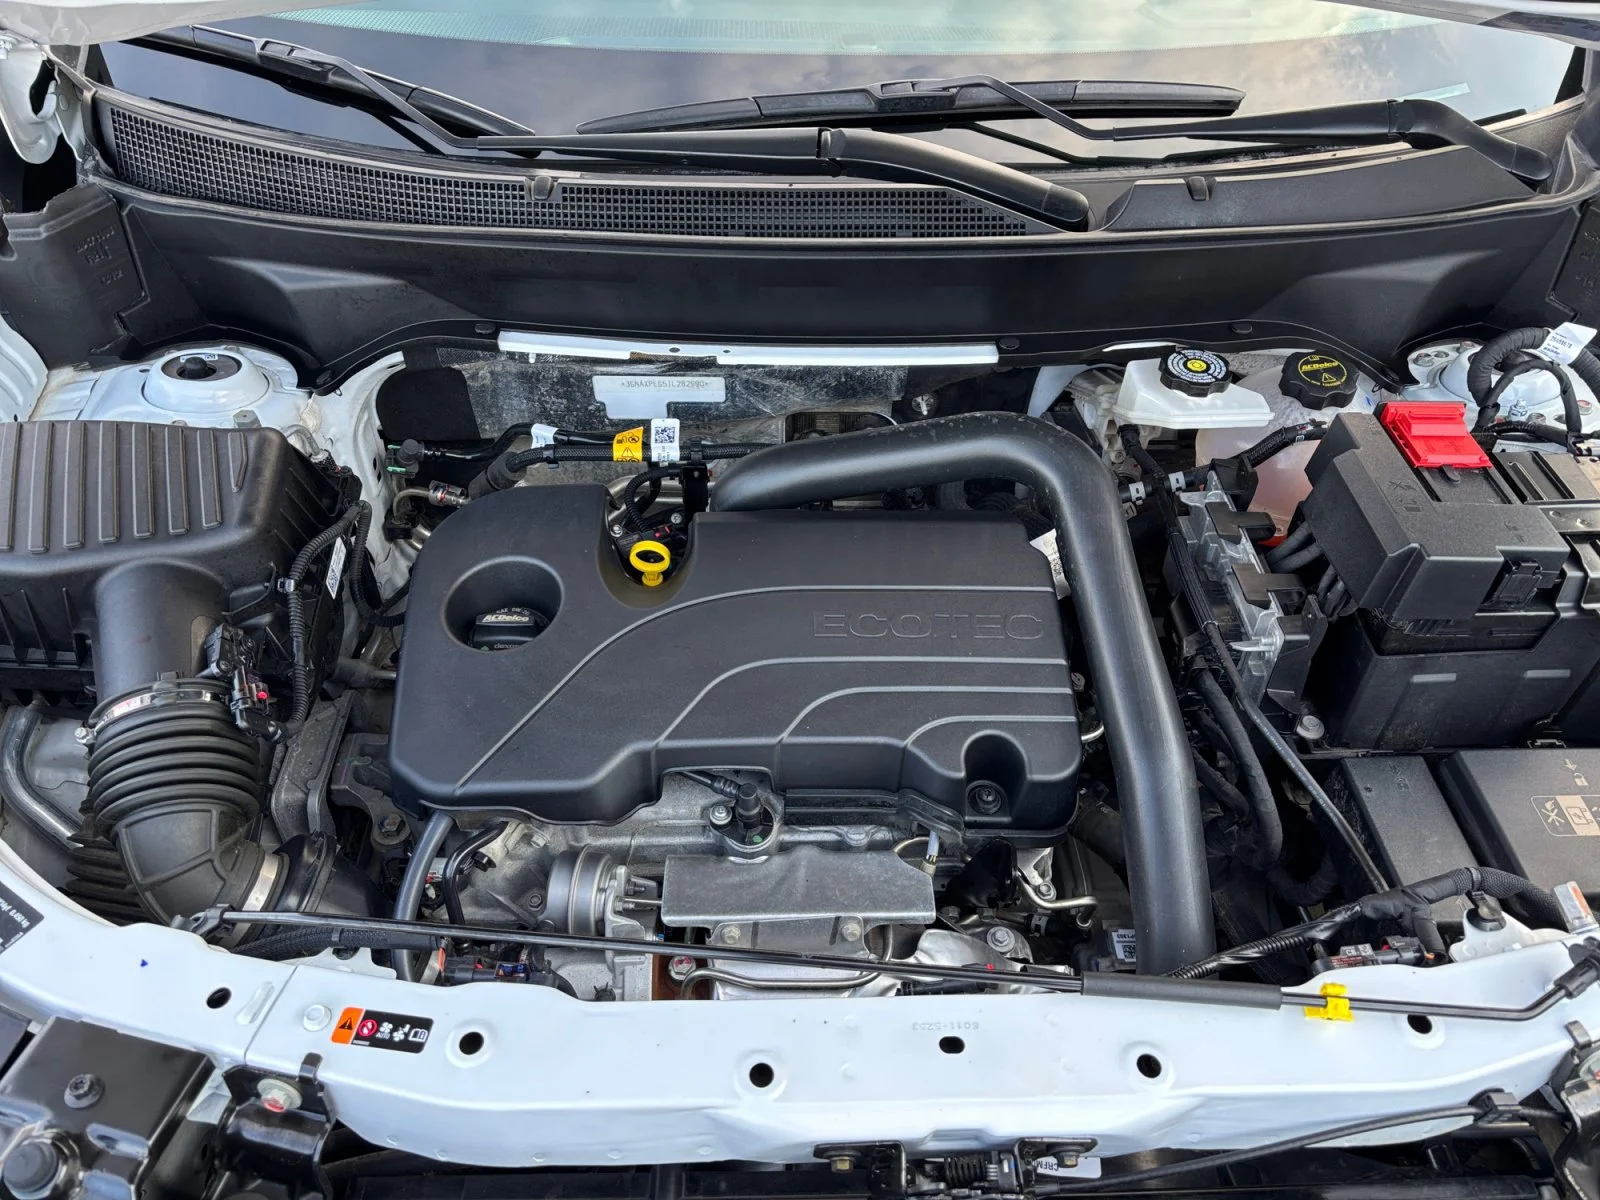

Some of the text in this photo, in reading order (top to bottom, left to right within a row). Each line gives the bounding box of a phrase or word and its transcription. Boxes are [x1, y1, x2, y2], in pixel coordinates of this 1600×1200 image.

[1301, 361, 1339, 372] ACDelco
[481, 614, 530, 623] ACDelco
[813, 611, 1044, 640] ECOTEC
